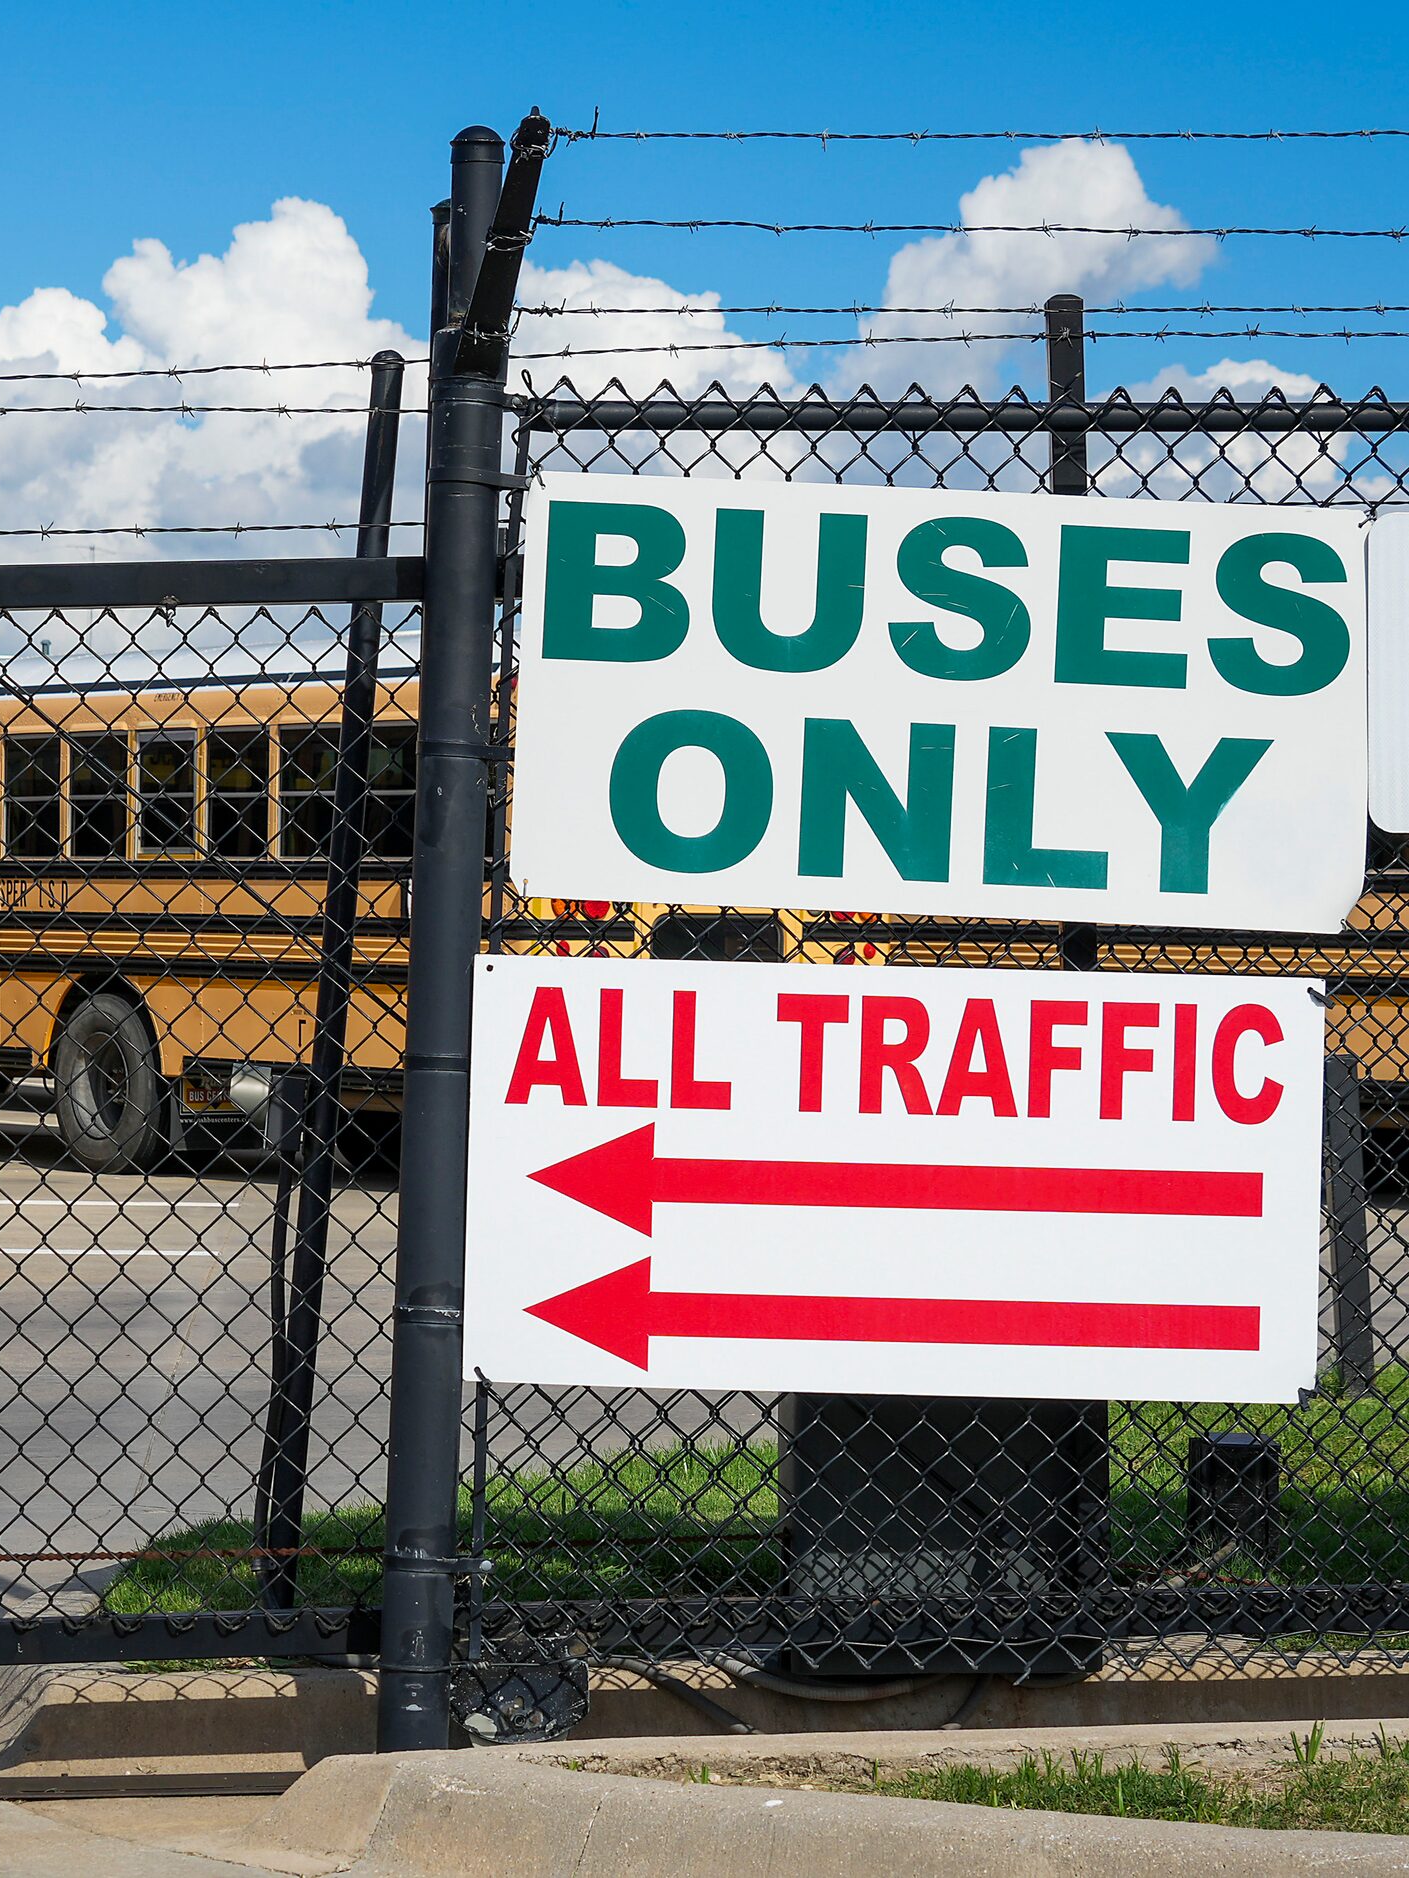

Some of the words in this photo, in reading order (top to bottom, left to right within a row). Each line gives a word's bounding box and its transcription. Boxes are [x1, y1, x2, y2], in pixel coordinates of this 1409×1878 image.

[541, 499, 1351, 697] BUSES
[608, 708, 1275, 895] ONLY
[189, 1090, 205, 1102] BUS
[504, 986, 732, 1111] ALL
[776, 993, 1285, 1126] TRAFFIC
